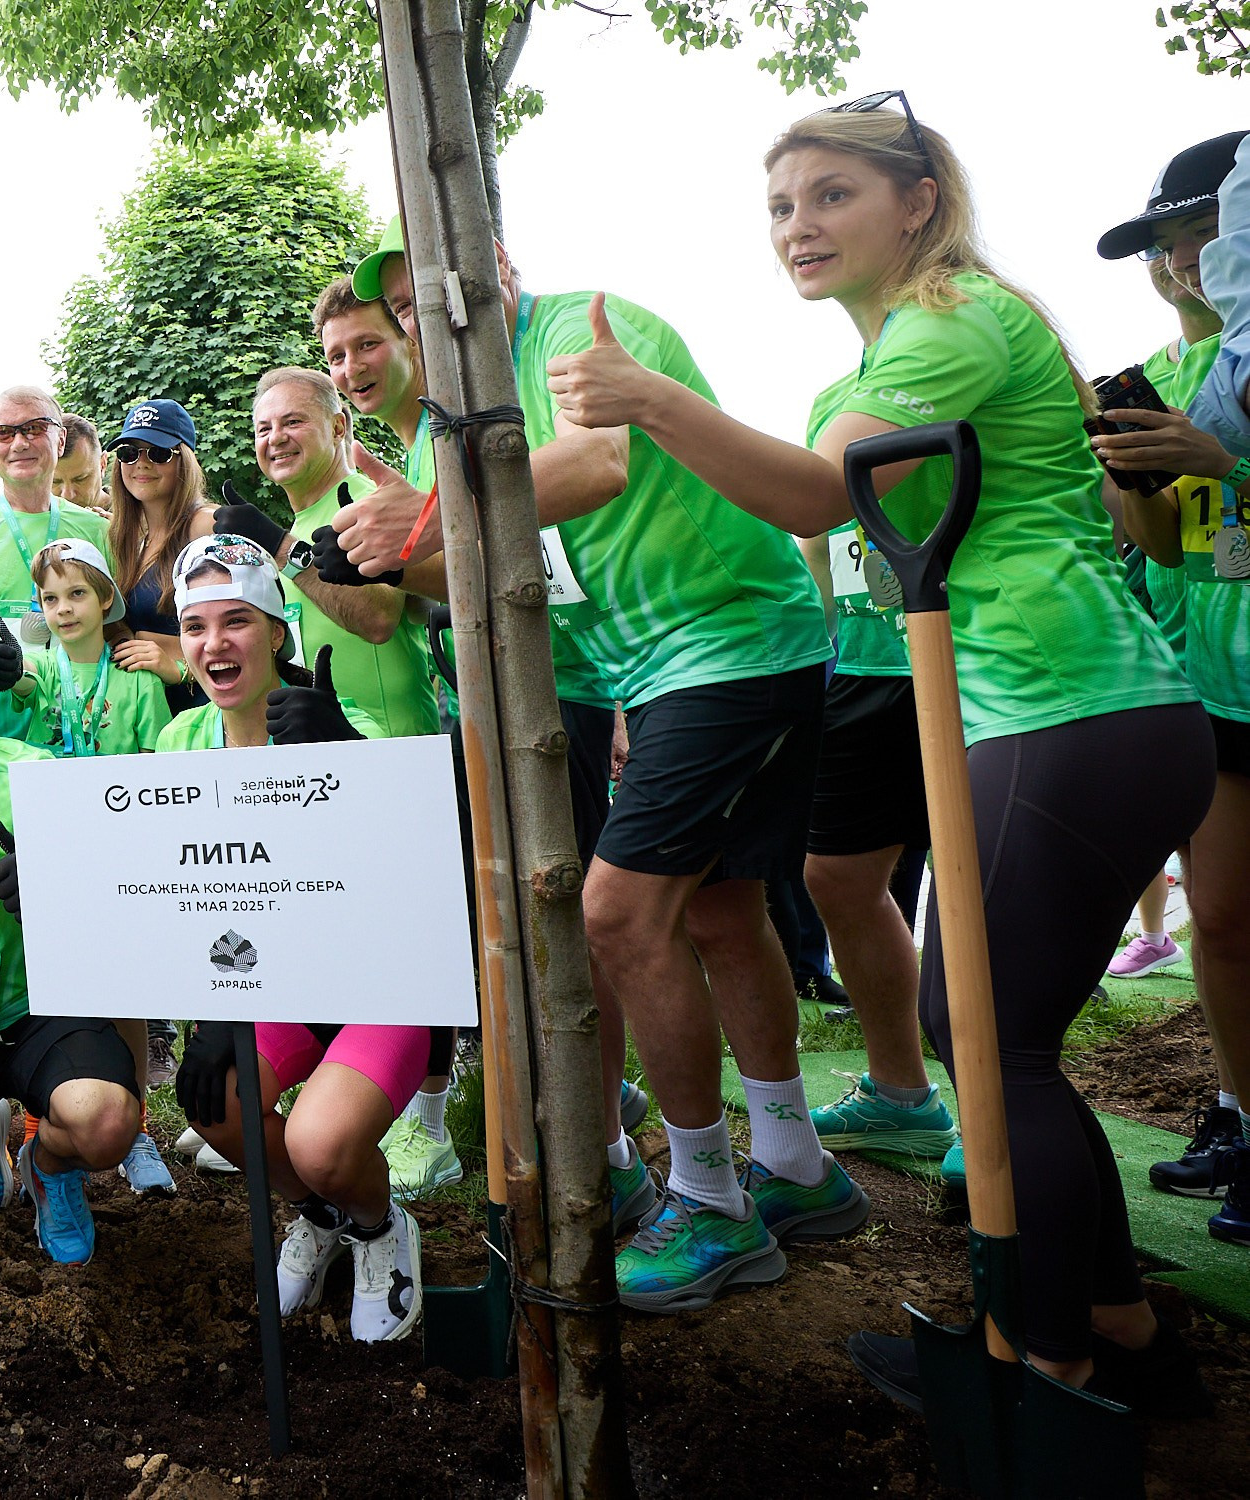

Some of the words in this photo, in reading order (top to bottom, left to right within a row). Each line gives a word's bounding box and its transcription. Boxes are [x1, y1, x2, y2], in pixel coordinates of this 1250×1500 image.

[520, 301, 530, 317] 2025
[878, 387, 935, 415] СБЕР
[240, 775, 306, 791] зелёный
[138, 786, 202, 806] СБЕР
[233, 791, 301, 806] марафон
[179, 841, 271, 866] ЛИПА
[117, 883, 200, 895] ПОСАЖЕНА
[203, 879, 292, 896] КОМАНДОЙ
[295, 880, 346, 893] СБЕРА
[178, 901, 191, 912] 31
[196, 901, 228, 912] МАЯ
[232, 900, 264, 911] 2025
[268, 900, 281, 911] Г.
[210, 980, 263, 991] ЗАРЯДЬЕ
